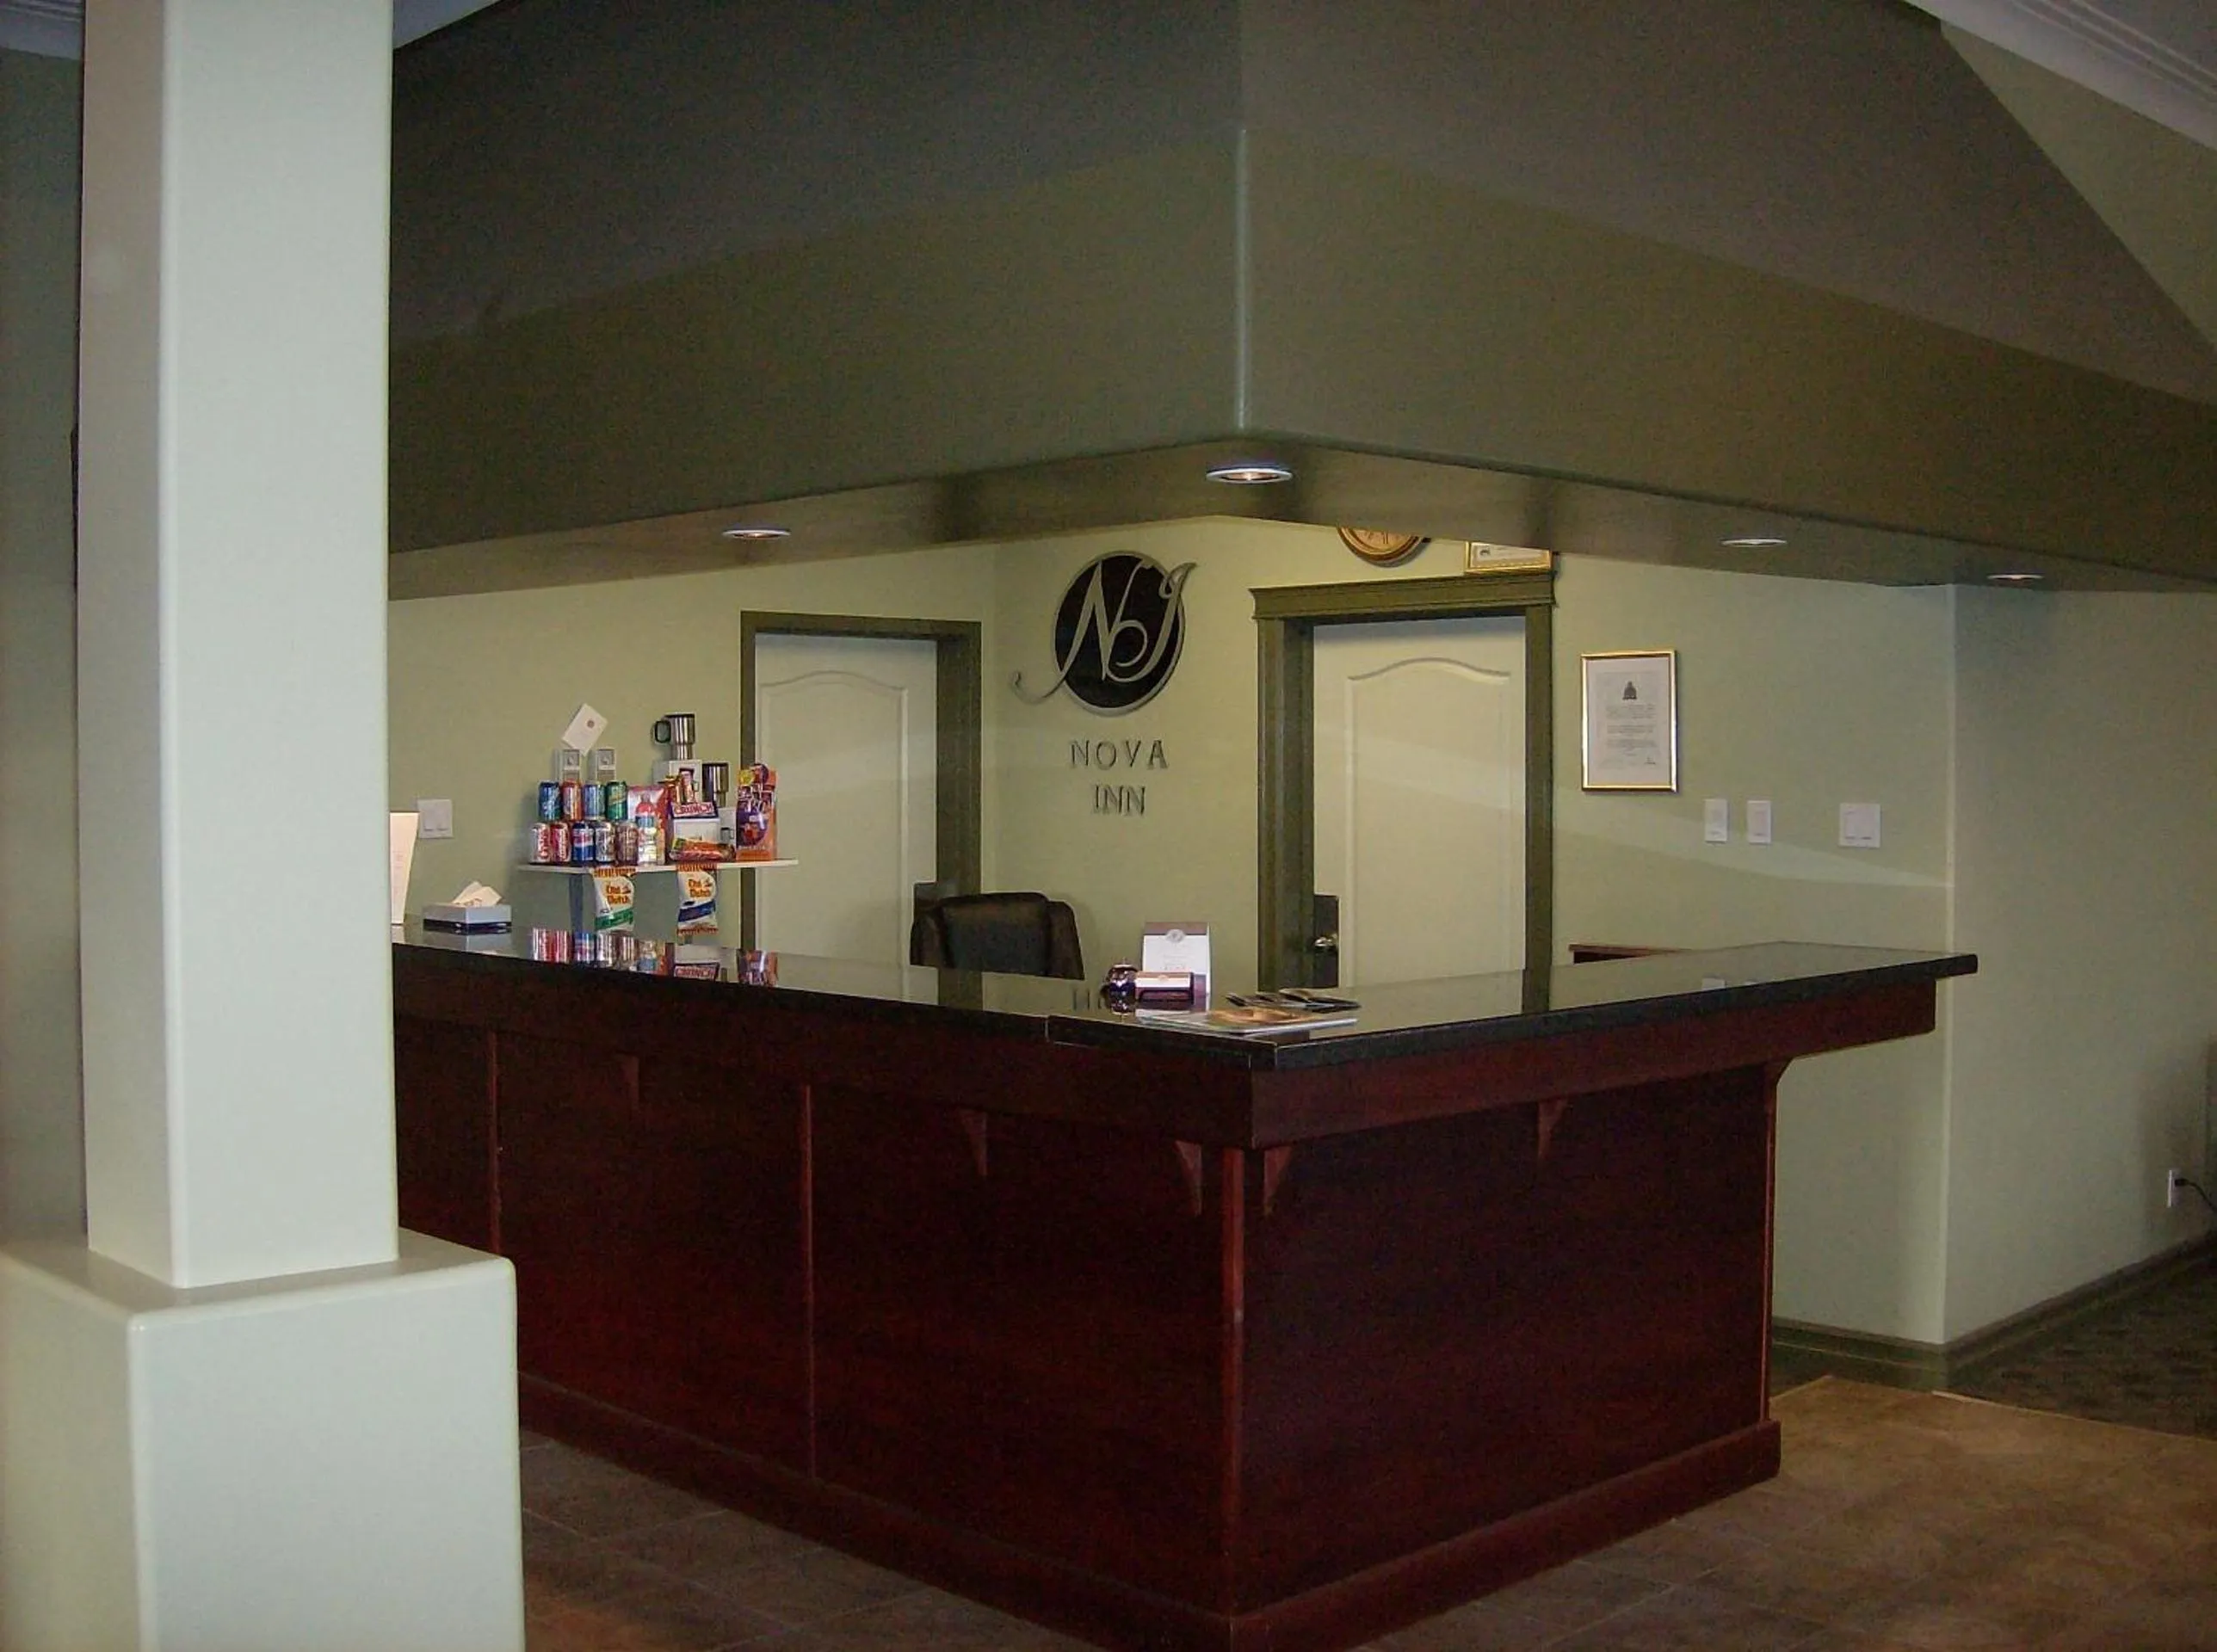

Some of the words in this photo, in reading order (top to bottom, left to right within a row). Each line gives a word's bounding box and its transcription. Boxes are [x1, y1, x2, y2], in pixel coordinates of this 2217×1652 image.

[1069, 738, 1170, 770] NOVA
[674, 801, 713, 817] CRUNCH
[1092, 782, 1146, 816] INN
